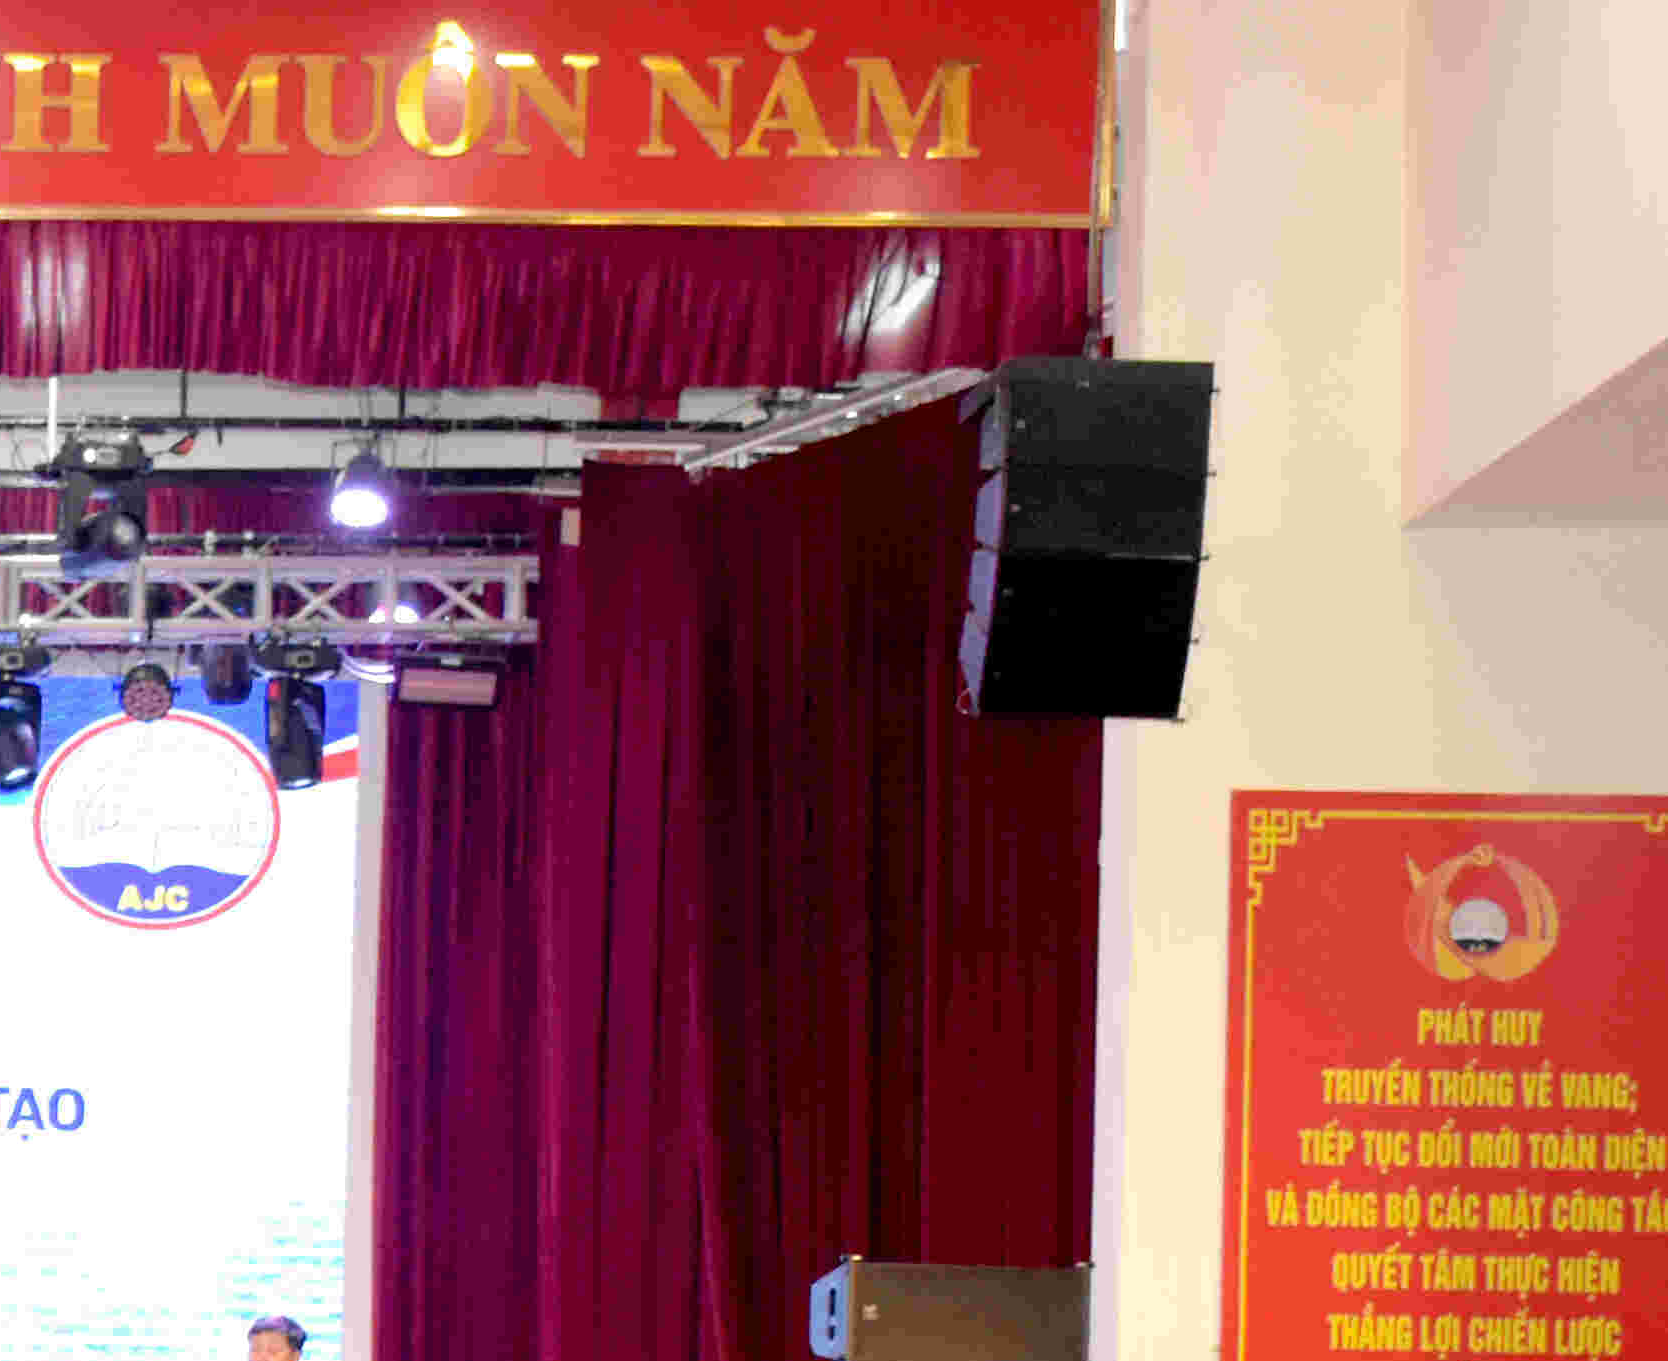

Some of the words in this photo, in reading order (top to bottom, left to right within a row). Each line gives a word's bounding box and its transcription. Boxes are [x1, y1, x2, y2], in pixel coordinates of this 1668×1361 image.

[157, 22, 598, 160] MUÔN
[640, 26, 981, 160] NĂM
[117, 884, 190, 912] AJC
[1417, 1001, 1484, 1046] PHÁT
[1491, 1008, 1543, 1046] HUY
